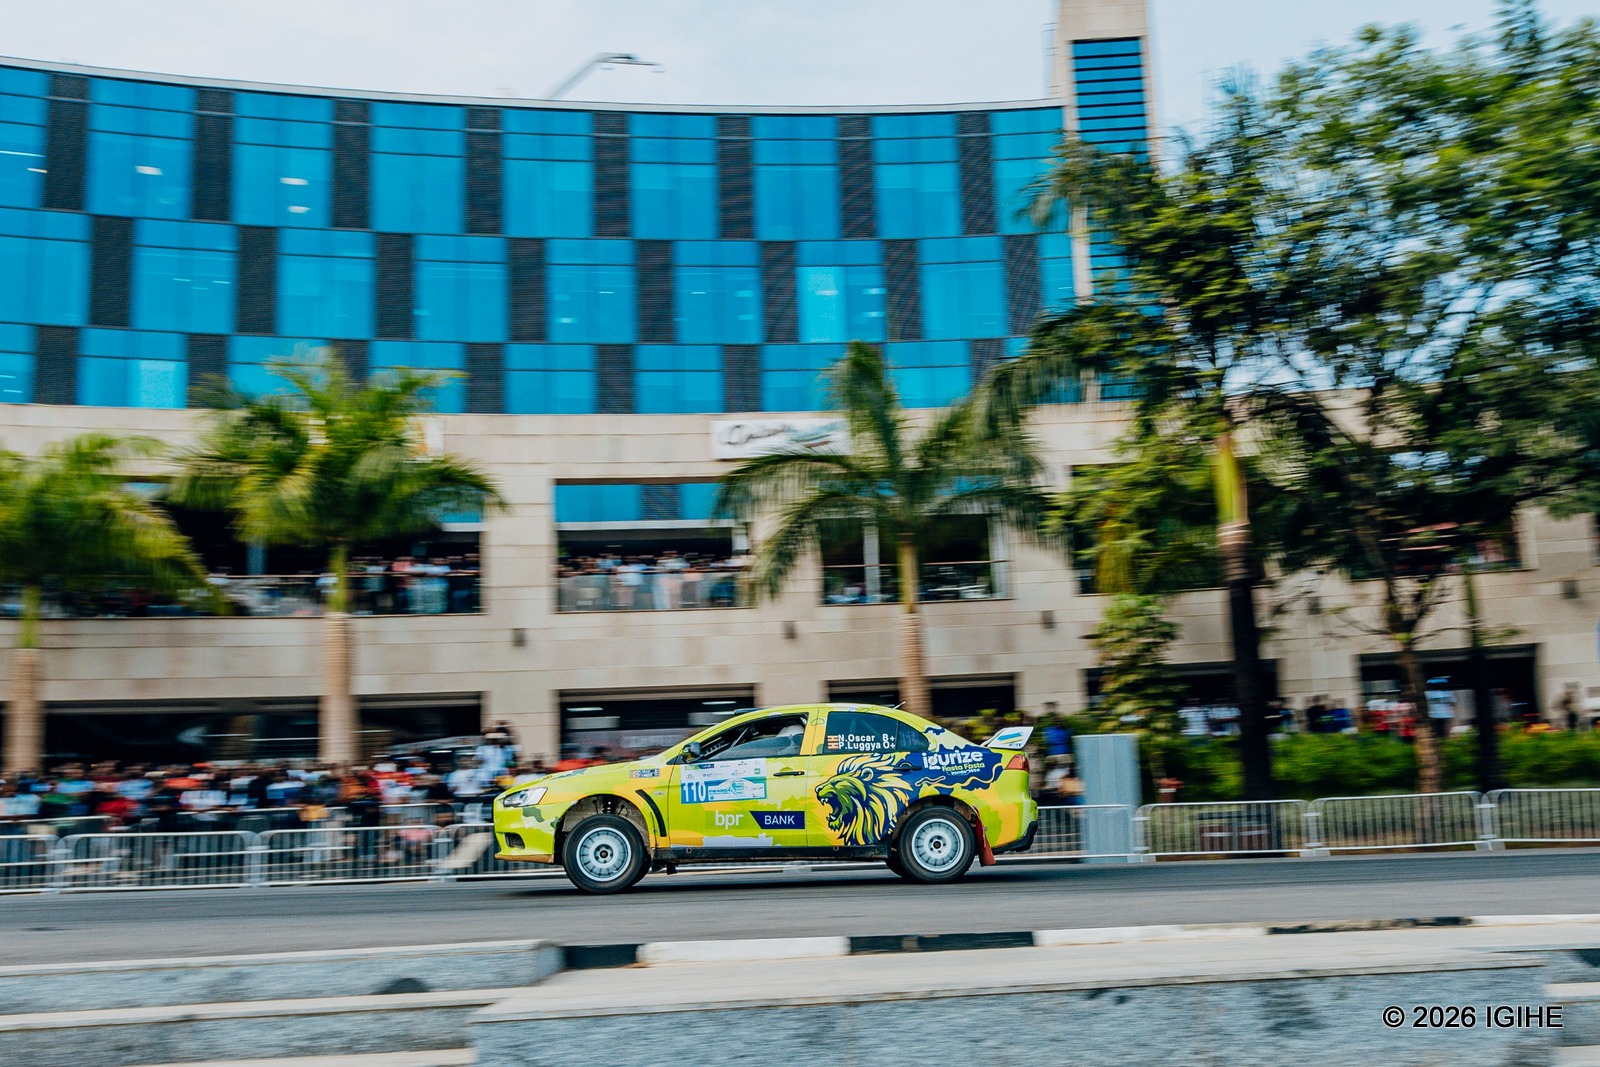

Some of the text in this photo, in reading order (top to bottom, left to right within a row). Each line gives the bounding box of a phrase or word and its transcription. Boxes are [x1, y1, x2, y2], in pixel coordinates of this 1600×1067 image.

[838, 733, 895, 742] N.Oscar B+
[838, 742, 881, 751] P.Luggya
[921, 749, 983, 770] igurize
[683, 781, 707, 803] 110
[715, 810, 795, 830] bpr BANK
